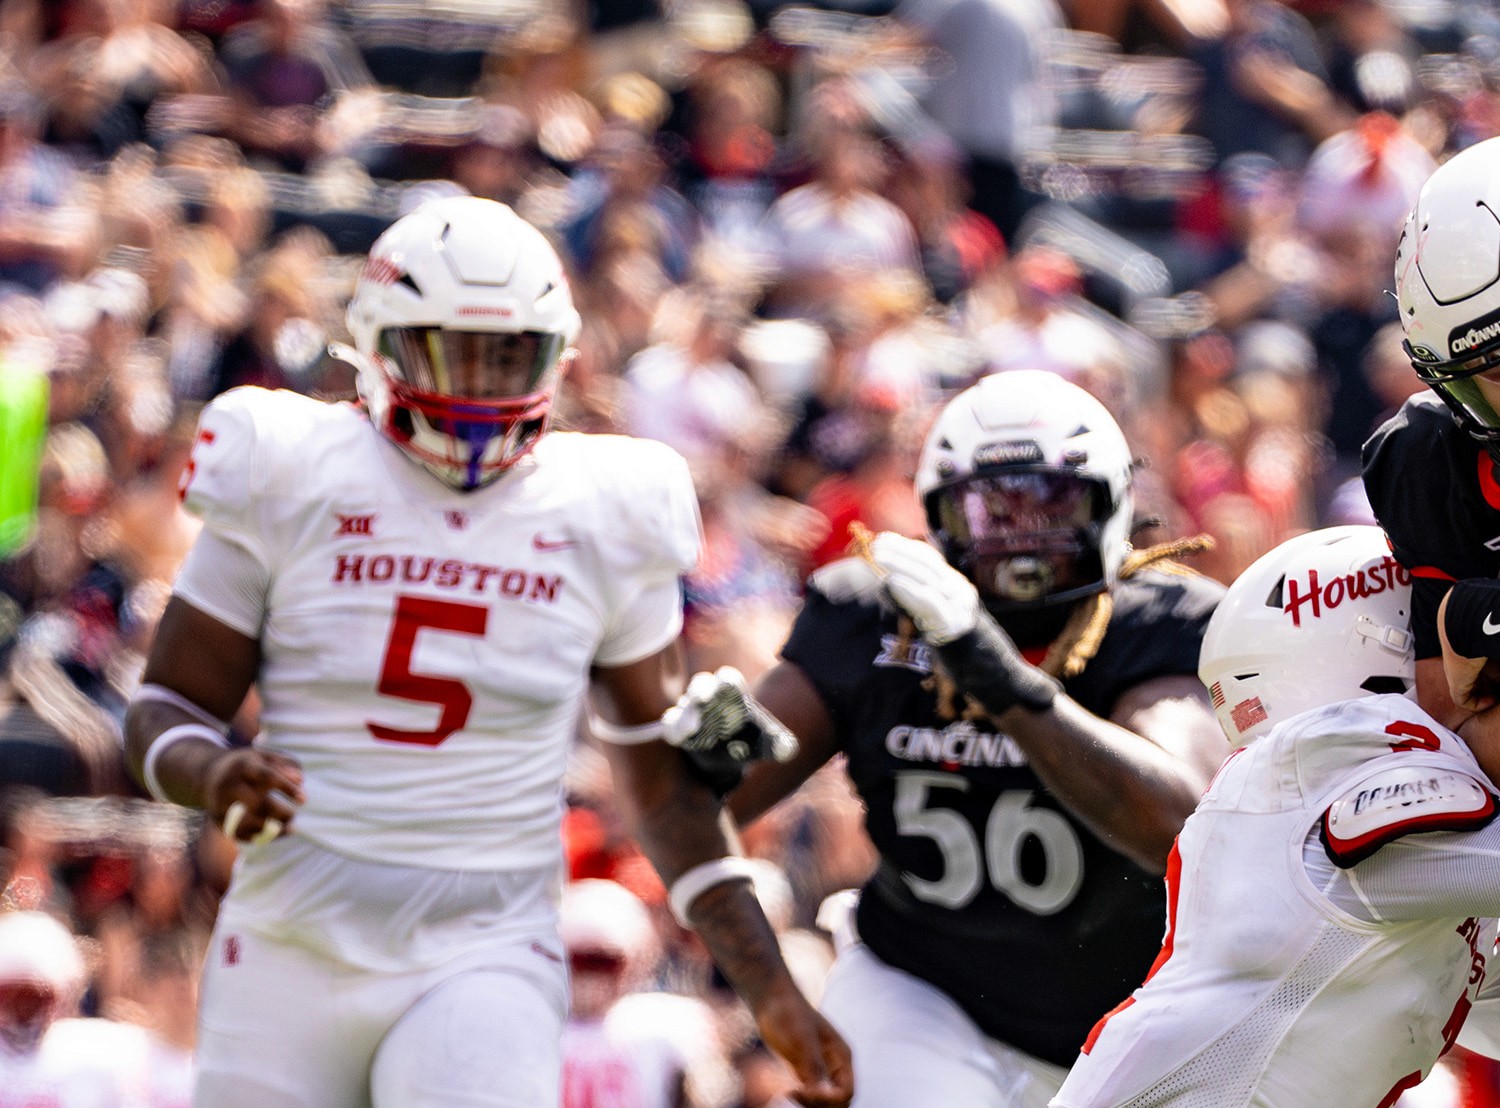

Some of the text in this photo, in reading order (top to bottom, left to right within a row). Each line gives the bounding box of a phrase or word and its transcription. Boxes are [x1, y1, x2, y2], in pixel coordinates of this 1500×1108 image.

[332, 554, 565, 604] HOUSTON
[1283, 555, 1413, 629] Housto
[366, 591, 490, 750] 5
[884, 722, 1028, 768] CINCINN
[892, 768, 1085, 916] 56
